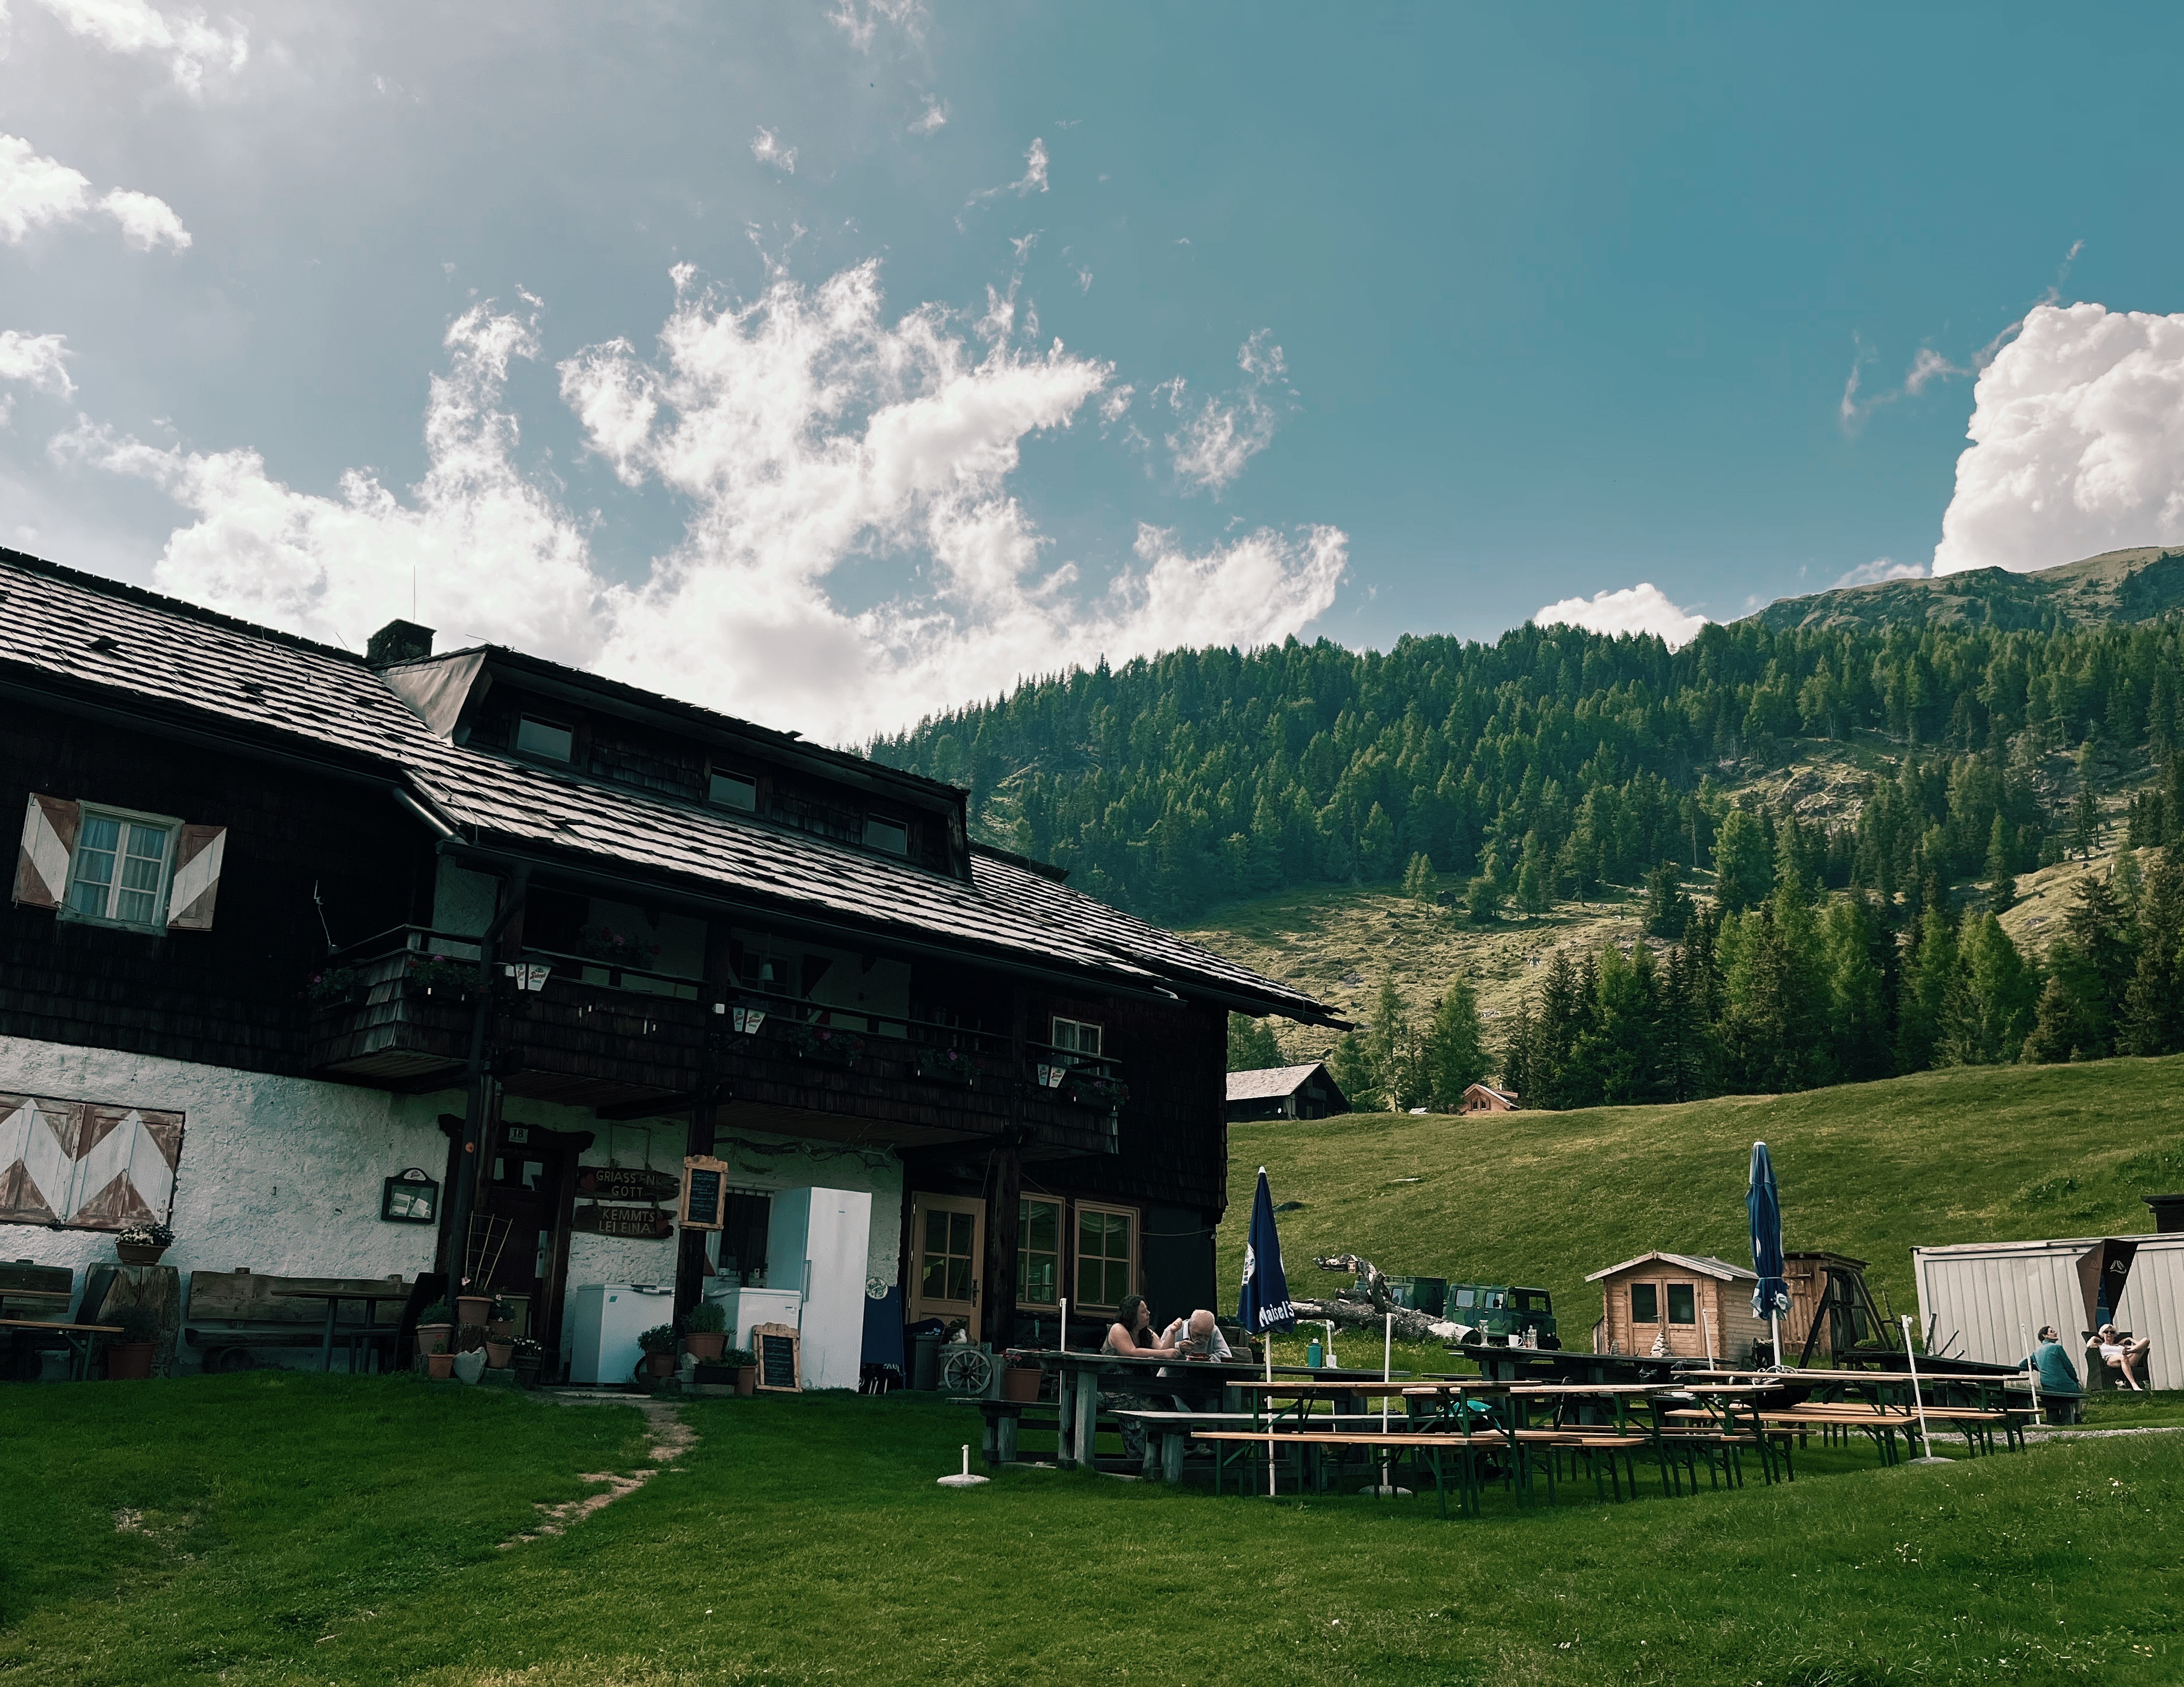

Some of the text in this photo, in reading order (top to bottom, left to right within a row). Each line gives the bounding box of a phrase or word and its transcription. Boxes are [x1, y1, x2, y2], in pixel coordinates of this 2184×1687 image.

[513, 1129, 524, 1138] 18
[596, 1170, 636, 1183] GRIASS
[611, 1186, 644, 1198] GOTT
[602, 1209, 655, 1222] KEMMTS
[599, 1221, 651, 1234] LEI EINA
[1260, 1300, 1295, 1327] Maisel's
